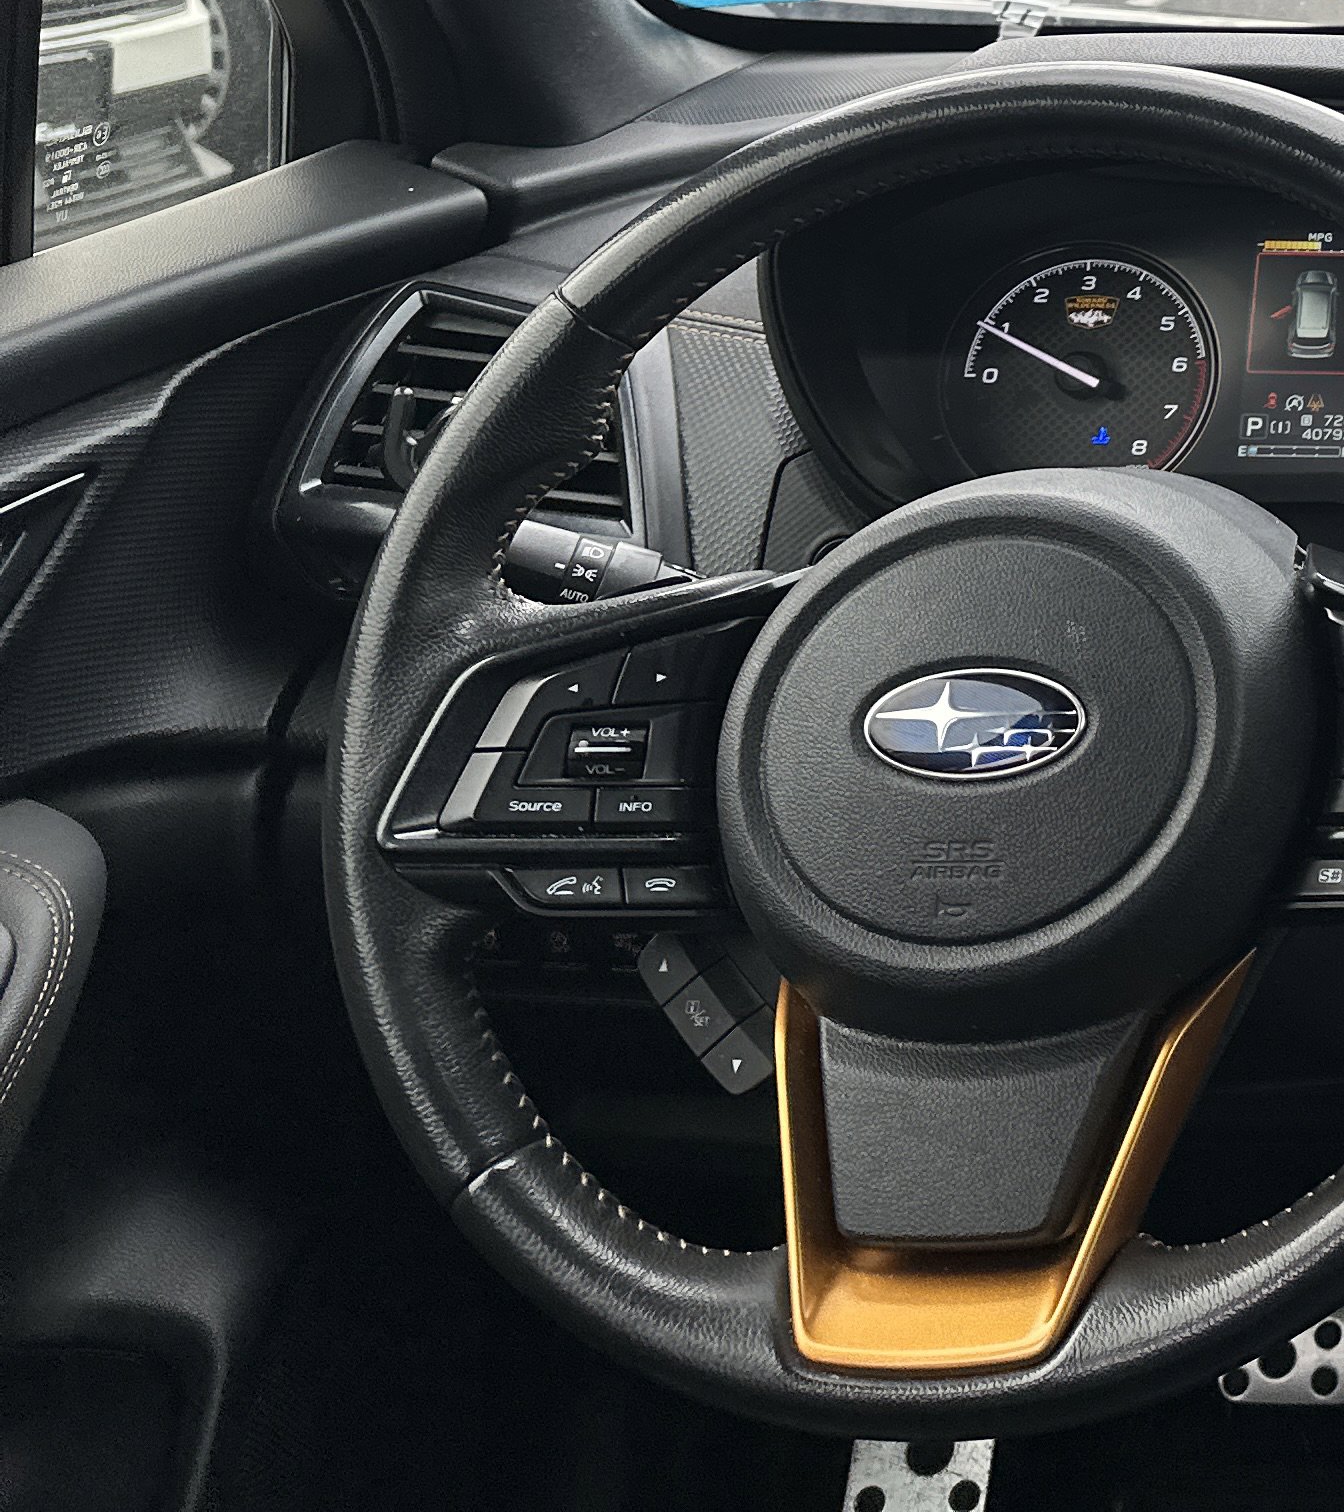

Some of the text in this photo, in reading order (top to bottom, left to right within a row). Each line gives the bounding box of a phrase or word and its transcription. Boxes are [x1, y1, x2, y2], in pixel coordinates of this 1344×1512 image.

[1308, 232, 1334, 243] MPG
[1081, 275, 1097, 291] 3
[1033, 288, 1050, 304] 2
[1126, 286, 1142, 301] 4
[1159, 316, 1176, 331] 5
[1172, 356, 1188, 372] 6
[982, 367, 999, 384] 0
[1163, 404, 1179, 420] 7
[1246, 416, 1264, 437] P
[1131, 439, 1148, 456] 8
[1237, 445, 1247, 458] E
[559, 588, 590, 603] AUTO
[508, 799, 563, 813] Source
[618, 801, 653, 813] INFO
[924, 841, 996, 860] SRS
[909, 864, 1003, 881] AIRBAG
